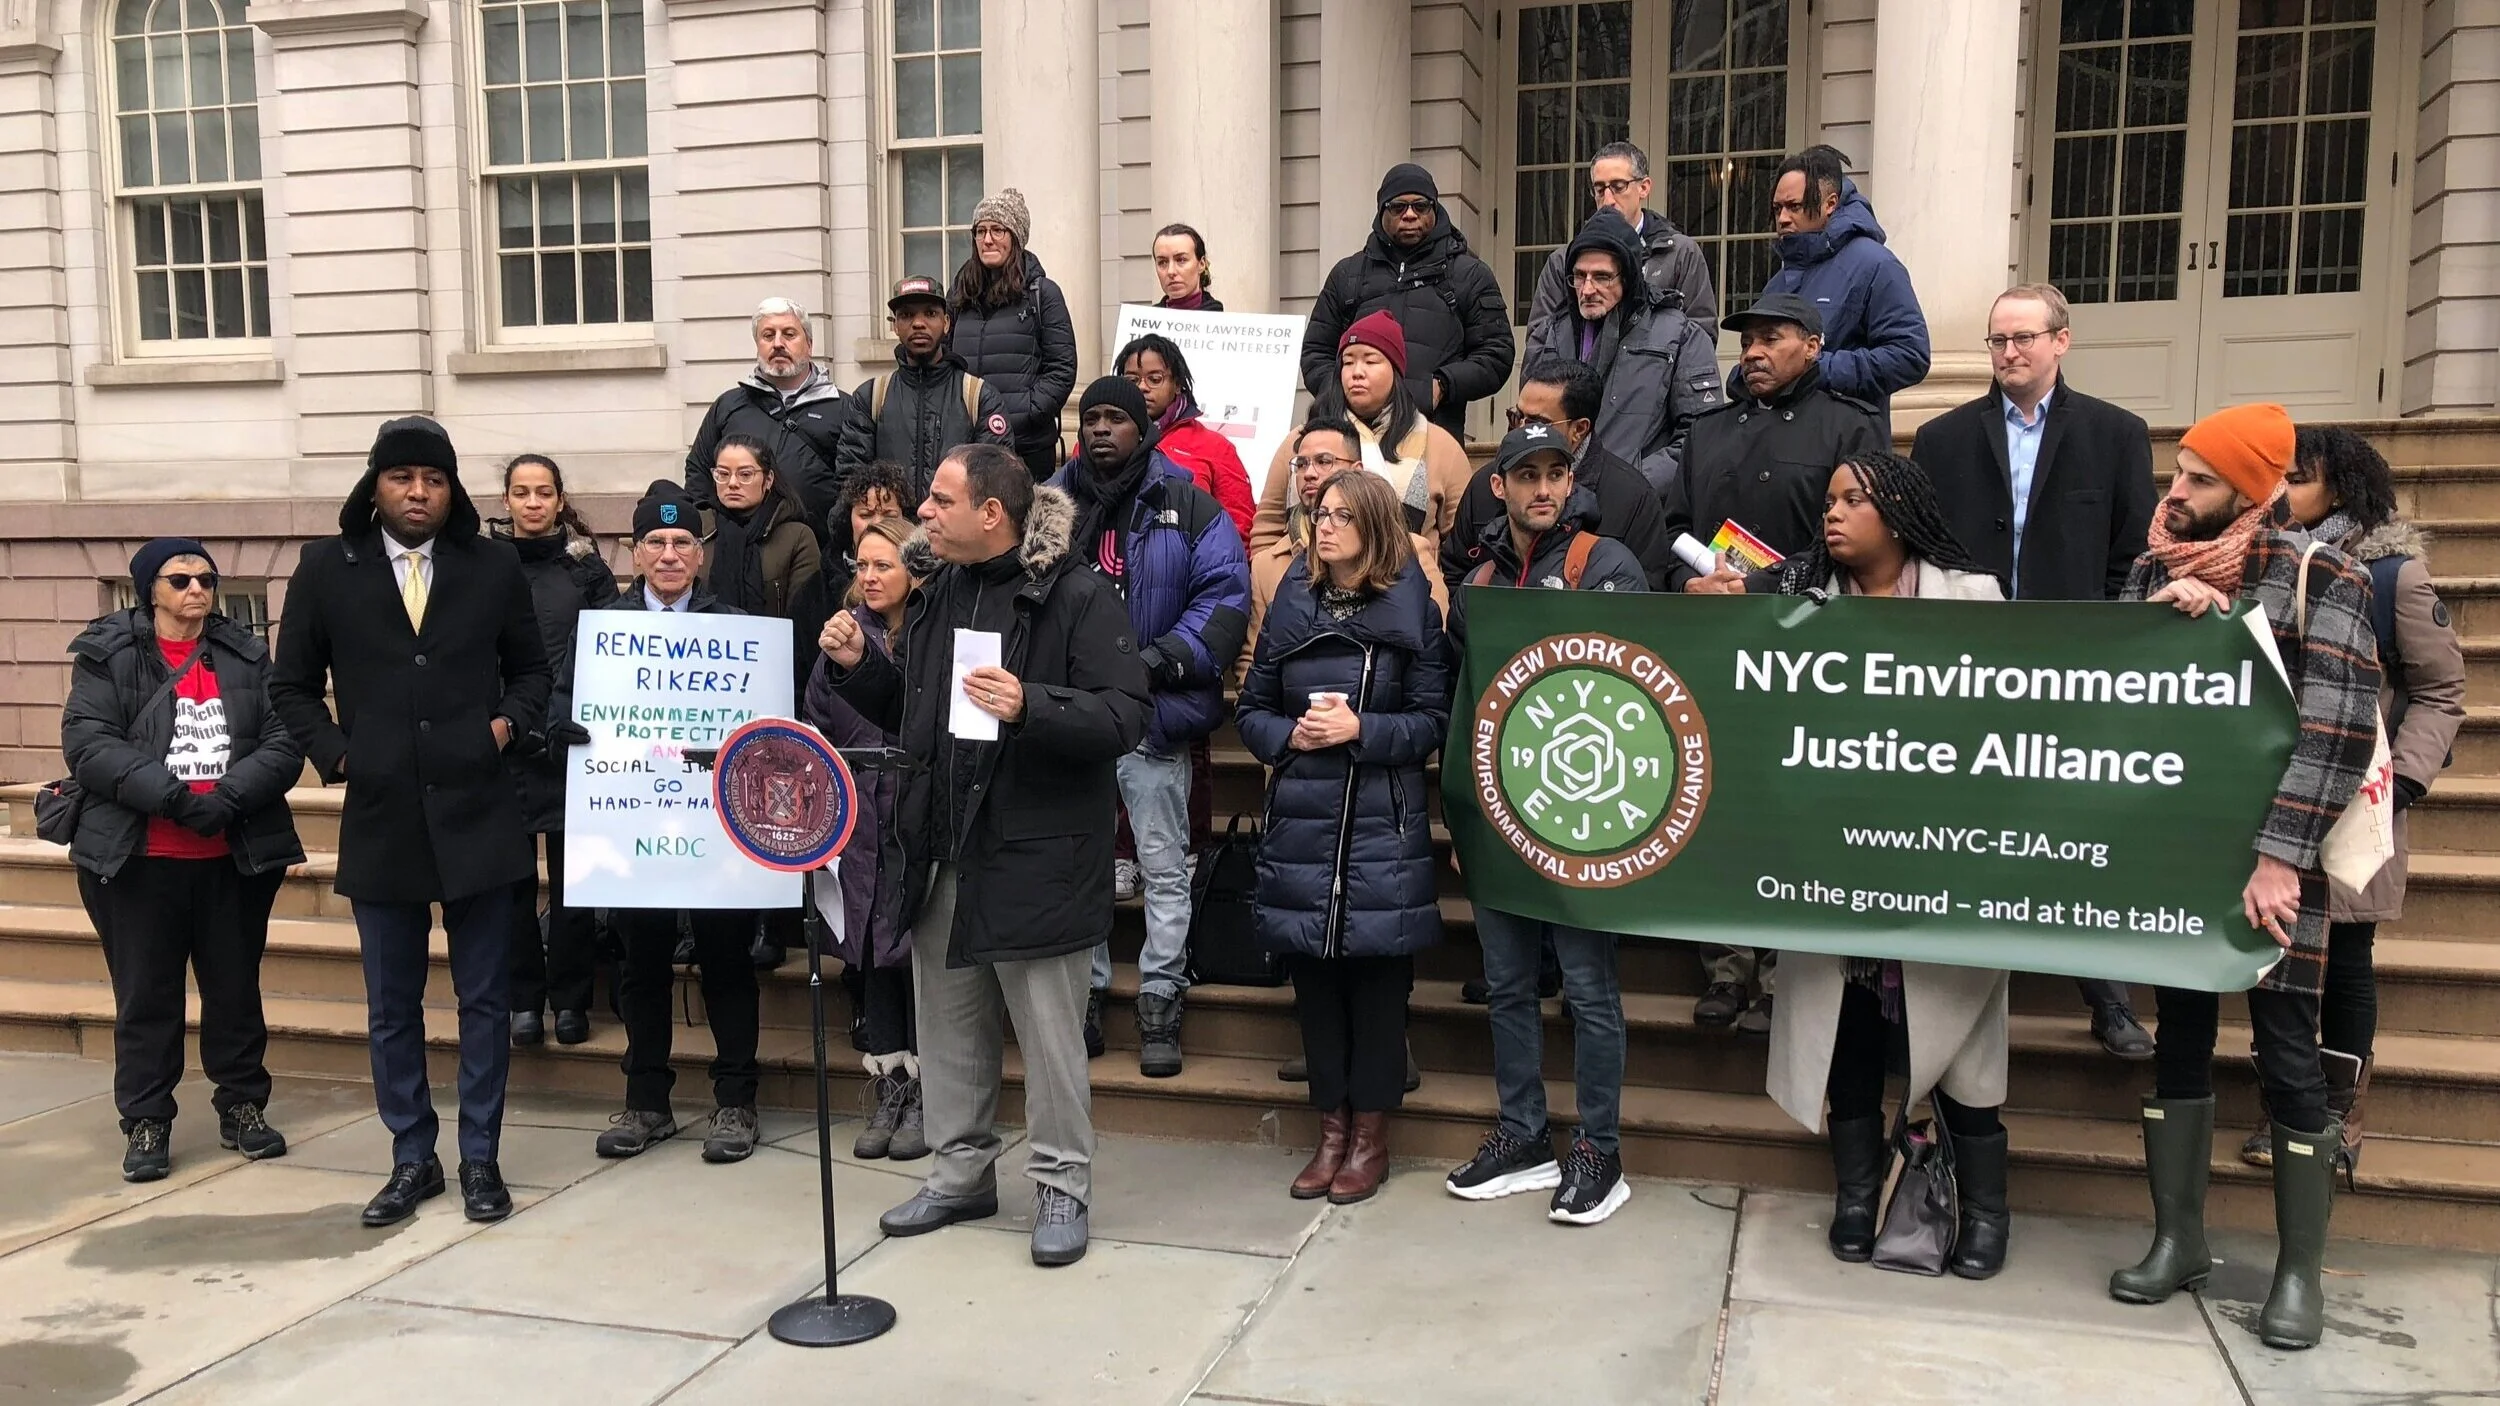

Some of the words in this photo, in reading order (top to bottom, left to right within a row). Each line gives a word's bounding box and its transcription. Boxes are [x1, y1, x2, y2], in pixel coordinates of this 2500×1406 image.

[1131, 318, 1162, 329] NEW
[1166, 321, 1200, 333] YORK
[1206, 324, 1262, 337] LAWYERS
[1267, 328, 1291, 338] FOR
[1222, 341, 1290, 354] INTEREST
[596, 632, 760, 662] RENEWABLE
[636, 667, 751, 693] RIKERS!
[1497, 647, 1545, 698] NEW
[1549, 638, 1627, 667] YORK
[1631, 655, 1687, 706] CITY
[1735, 649, 1848, 694] NYC
[1863, 653, 2253, 707] Environmental
[652, 745, 690, 758] AN
[1510, 746, 1535, 769] 19
[1781, 725, 1958, 774] Justice
[1969, 732, 2184, 786] Alliance
[194, 761, 224, 776] York
[584, 759, 656, 775] SOCIAL
[1632, 756, 1660, 779] 91
[653, 779, 683, 793] GO
[1476, 718, 1570, 879] ENVIRONMENTAL
[1577, 838, 1669, 882] JUSTICE
[1665, 733, 1705, 843] ALLIANCE
[635, 836, 707, 858] NRDC
[772, 831, 795, 841] 1625
[1842, 826, 2109, 868] www.NYC-EJA.org
[1756, 875, 1796, 901] On
[1801, 880, 1846, 905] the
[1850, 889, 1949, 915] ground
[1978, 896, 2030, 922] and
[2036, 900, 2066, 925] at
[2071, 901, 2121, 929] the
[2127, 906, 2204, 936] table
